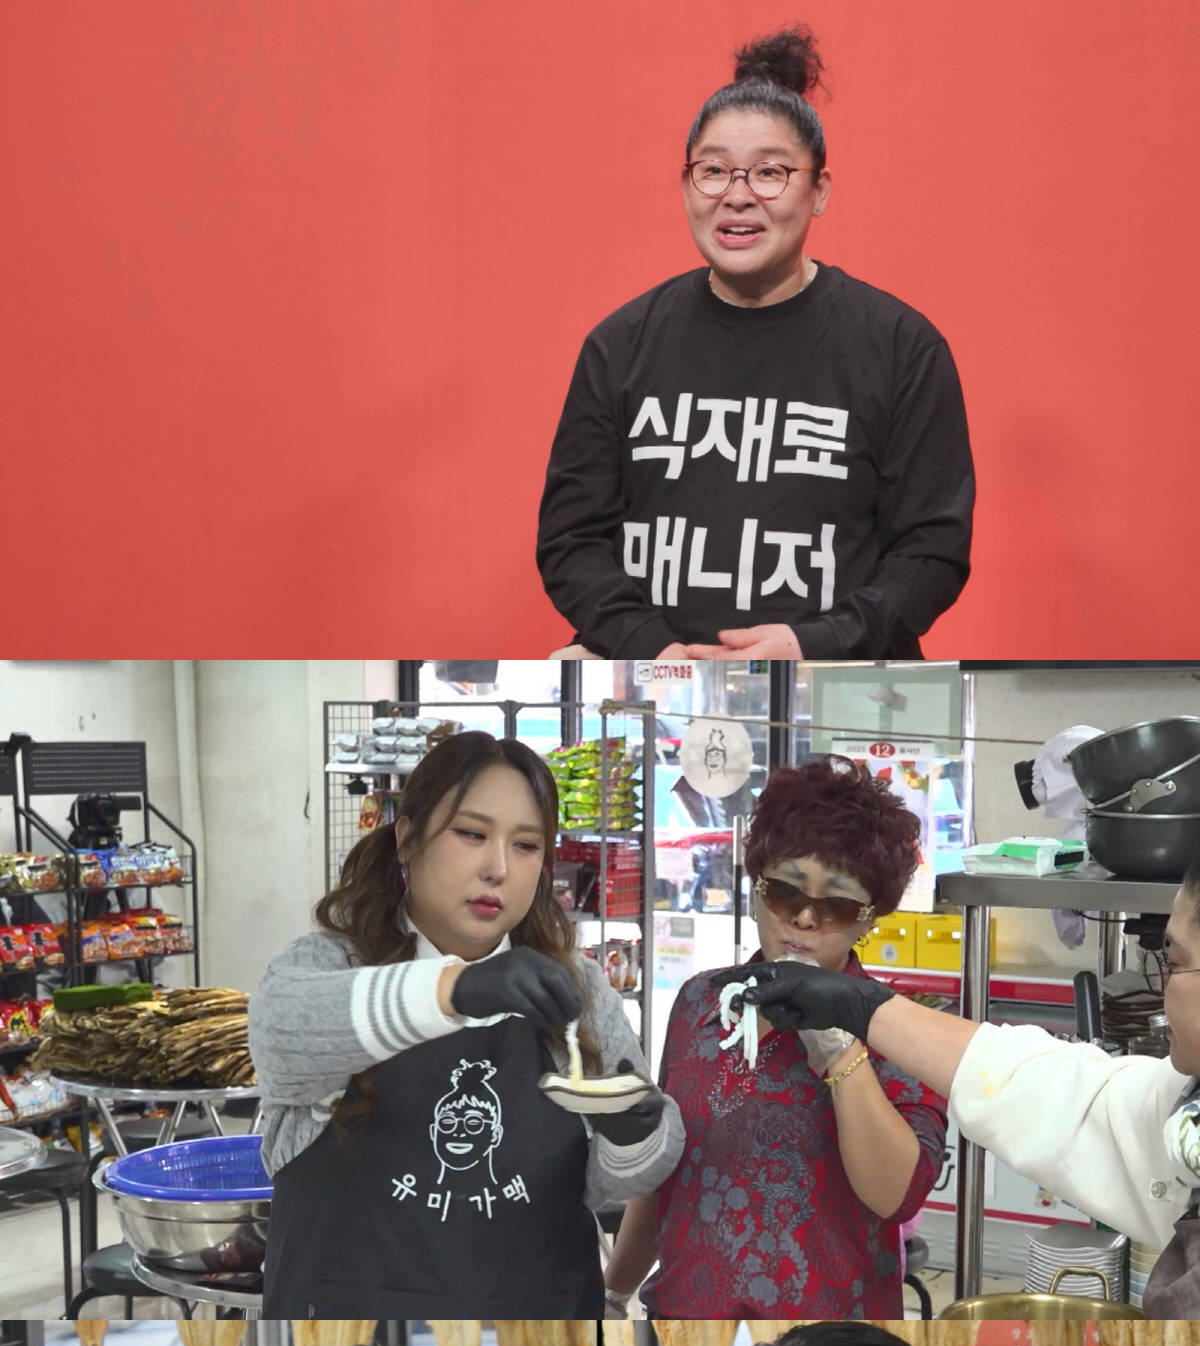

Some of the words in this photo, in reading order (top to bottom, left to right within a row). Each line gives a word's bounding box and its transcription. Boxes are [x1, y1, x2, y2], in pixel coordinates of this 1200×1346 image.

[628, 392, 849, 483] 식재료
[622, 516, 836, 612] 매니저
[875, 743, 891, 757] 12
